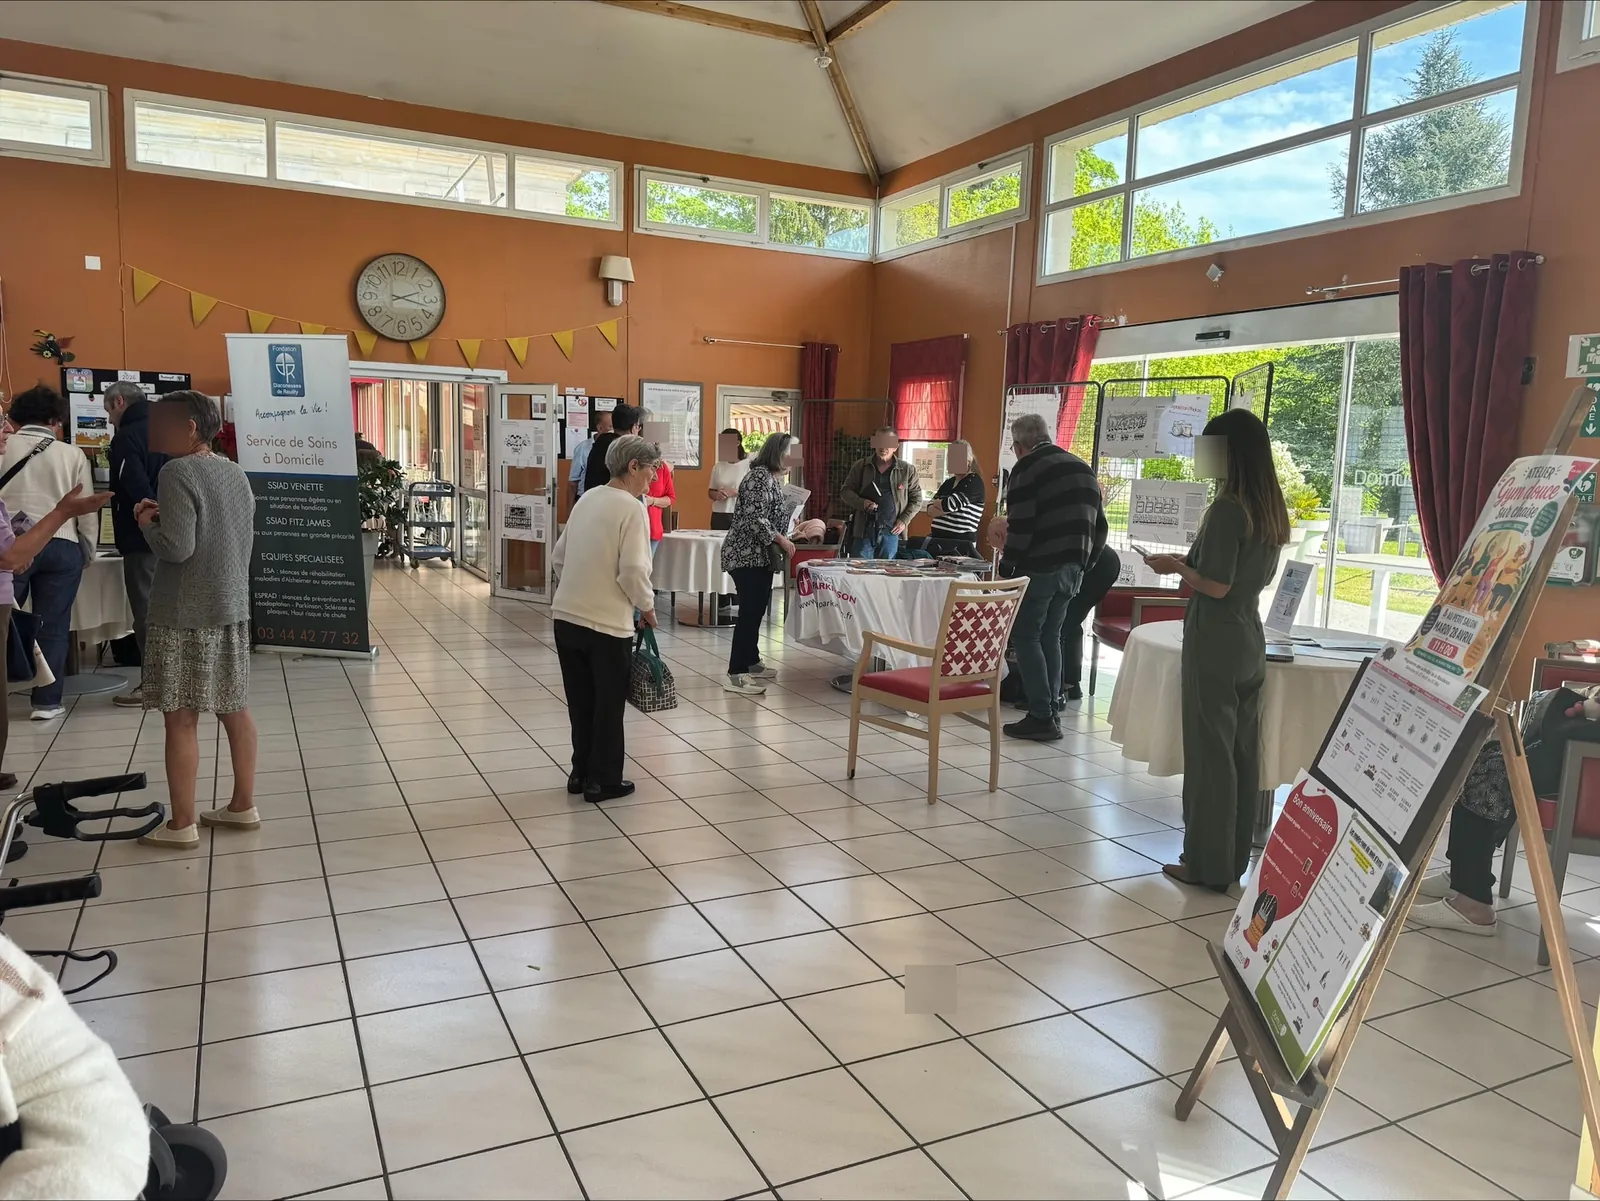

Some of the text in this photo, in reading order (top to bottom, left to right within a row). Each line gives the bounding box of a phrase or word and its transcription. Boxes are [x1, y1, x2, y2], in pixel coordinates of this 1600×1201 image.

[377, 264, 392, 279] 11
[392, 260, 406, 276] 12
[411, 267, 418, 279] 1
[365, 274, 382, 289] 10
[418, 279, 434, 292] 2
[362, 291, 378, 300] 9
[423, 295, 438, 304] 3
[368, 306, 382, 316] 8
[422, 308, 434, 320] 4
[380, 314, 394, 328] 7
[397, 320, 406, 334] 6
[410, 316, 422, 332] 5
[246, 434, 338, 449] Service de Soins
[263, 452, 324, 466] à Domicile
[1525, 466, 1556, 480] ATELIER
[267, 481, 324, 492] SSIAD VENETTE
[1494, 476, 1560, 508] Gym douce
[1495, 504, 1512, 519] sur
[1510, 500, 1539, 519] chaise
[265, 516, 331, 528] SSIAD FITZ JAMES
[261, 552, 344, 564] EQUIPES SPECIALISEES
[282, 576, 311, 584] d'Alzheimer
[312, 596, 341, 604] prévention
[812, 582, 856, 604] PARKISON
[305, 610, 322, 618] risque
[324, 603, 348, 612] Sclérose
[1462, 616, 1478, 629] SALON
[257, 626, 359, 644] 03 44 42 77 32
[1433, 620, 1474, 645] MARDI 28 AVRIL
[1292, 794, 1302, 808] Bon
[1302, 803, 1333, 835] anniversaire
